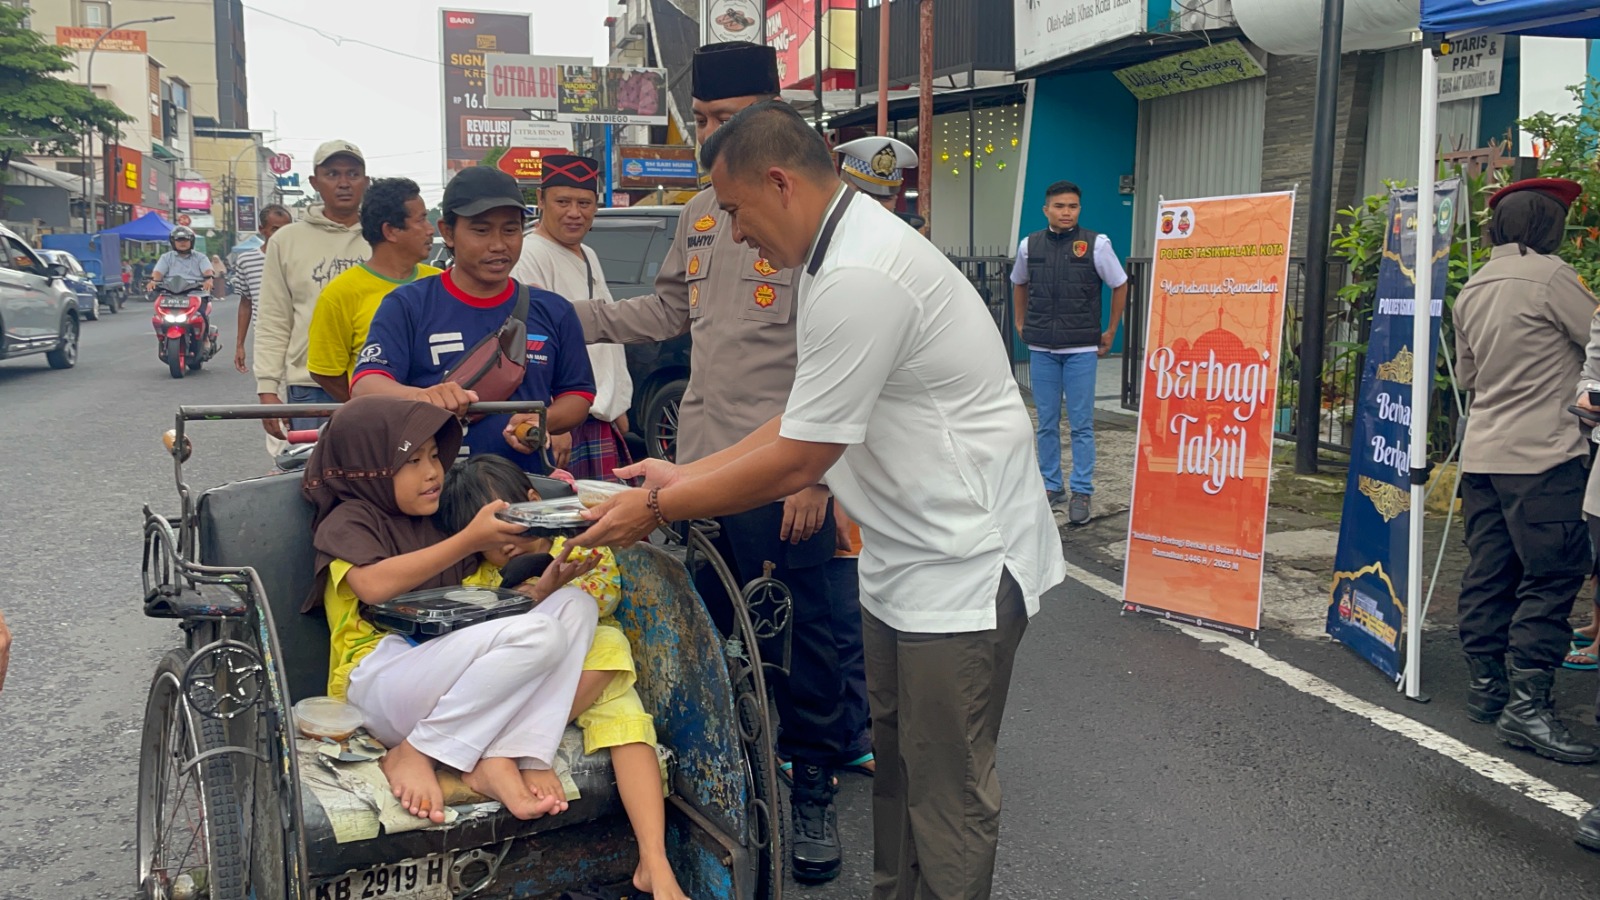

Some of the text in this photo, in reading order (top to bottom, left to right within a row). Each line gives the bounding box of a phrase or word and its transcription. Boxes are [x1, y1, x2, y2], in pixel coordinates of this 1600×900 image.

[449, 16, 475, 25] BARU
[1046, 7, 1077, 33] Oleh-oleh
[1077, 3, 1094, 22] Khas
[1095, 0, 1111, 15] Kota
[1449, 35, 1497, 56] OTARIS &
[1180, 58, 1245, 77] Sumping
[1452, 53, 1483, 71] PPAT
[463, 69, 486, 79] KRE
[493, 64, 536, 98] CITRA
[466, 119, 510, 133] REVOLUSI
[585, 114, 601, 122] SAN
[603, 115, 629, 123] DIEGO
[538, 129, 565, 137] BUNDO
[687, 234, 715, 249] WAHYU
[1160, 243, 1284, 260] POLRES TASIKMALAYA KOTA
[1160, 278, 1209, 296] Marhaban
[1222, 277, 1279, 295] Ramadhan
[1149, 346, 1271, 422] Berbagi
[1376, 392, 1412, 436] Berba
[1170, 413, 1247, 495] Takjil
[1152, 547, 1184, 561] Ramadhan
[1184, 553, 1201, 563] 1446
[1213, 558, 1231, 569] 2025
[1232, 562, 1239, 571] M
[1207, 544, 1215, 552] di
[1215, 545, 1234, 555] Bulan
[1353, 605, 1398, 647] PRESISI
[315, 857, 444, 900] KB 2919 H
